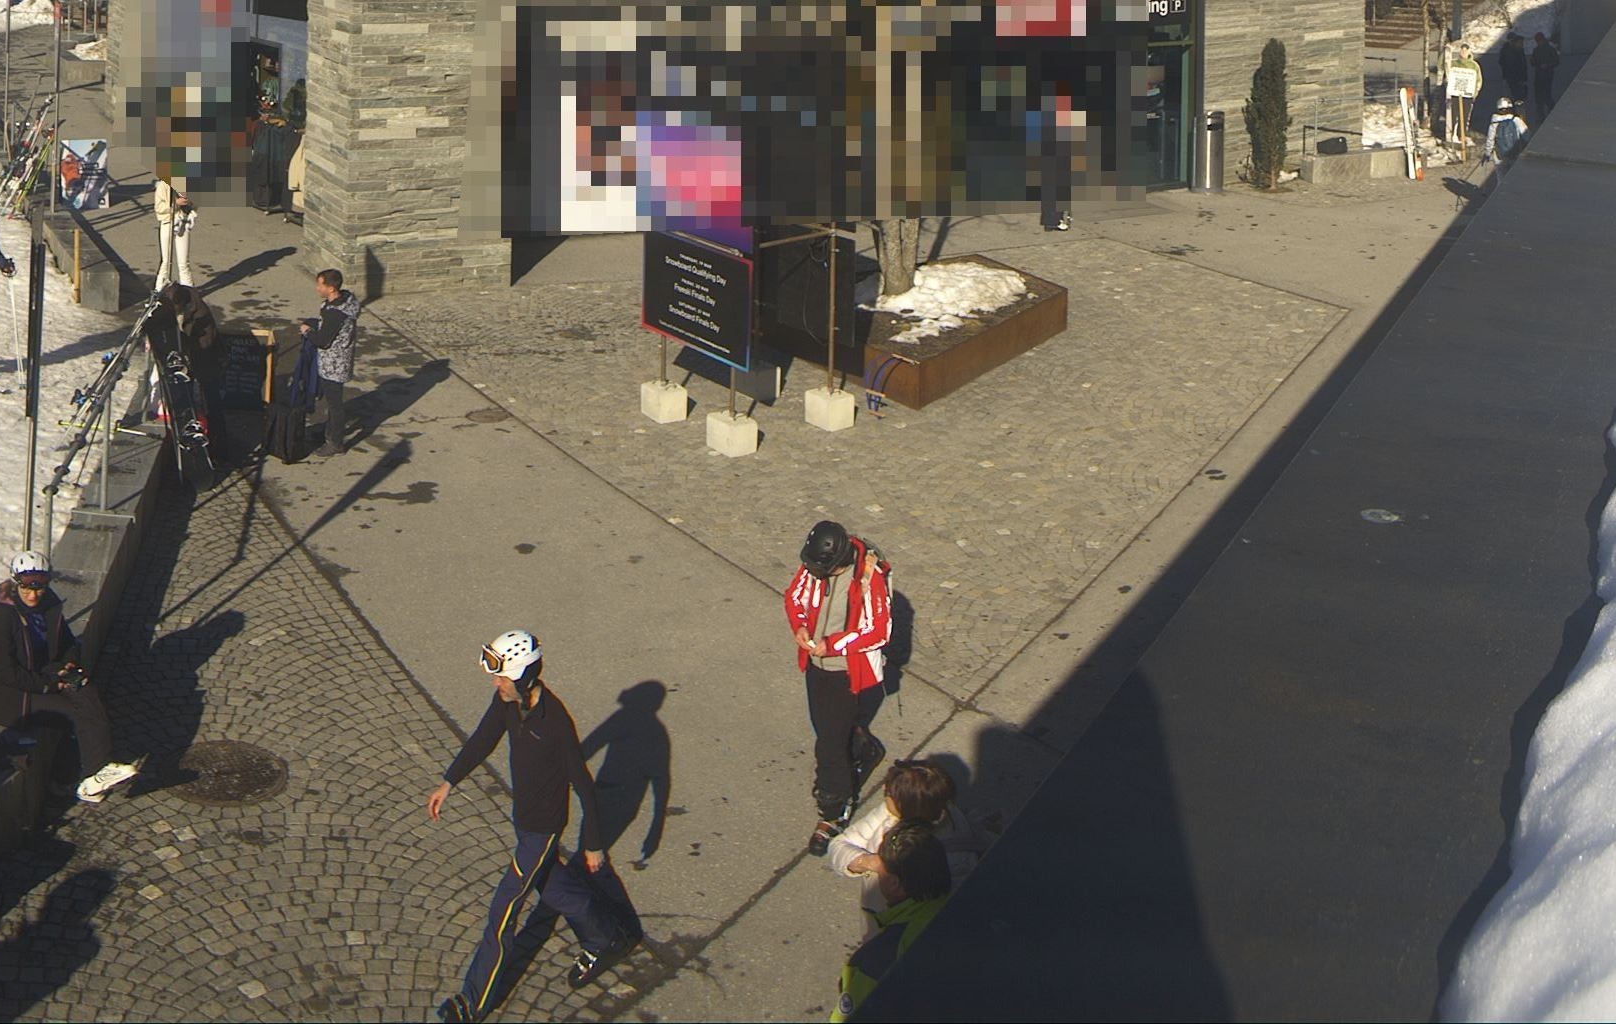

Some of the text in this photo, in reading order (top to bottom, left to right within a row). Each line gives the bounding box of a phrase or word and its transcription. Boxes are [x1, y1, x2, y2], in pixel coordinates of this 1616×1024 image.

[665, 255, 727, 288] Snowboard Qualifying Day
[705, 295, 716, 307] Day
[668, 304, 695, 322] Snowboard
[710, 321, 720, 334] Day
